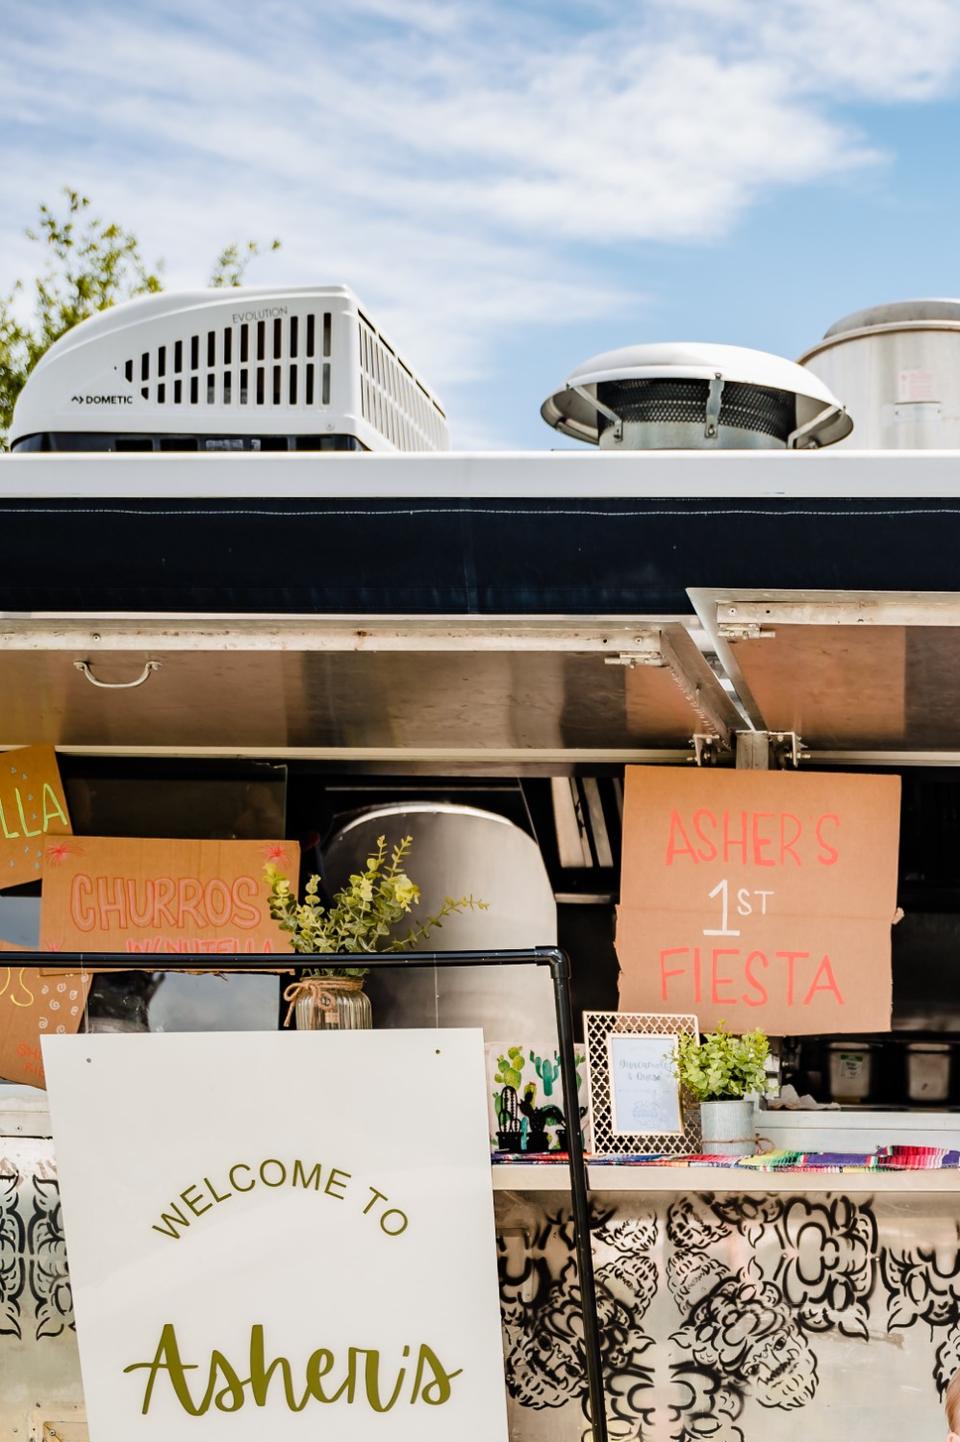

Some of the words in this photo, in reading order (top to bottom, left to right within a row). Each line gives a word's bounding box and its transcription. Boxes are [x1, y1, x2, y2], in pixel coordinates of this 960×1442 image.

[232, 306, 287, 322] EVOLUTION
[85, 395, 133, 404] DOMETIC
[0, 783, 68, 838] LLA
[664, 808, 841, 867] ASHER'S
[70, 873, 262, 933] CHURROS
[703, 879, 775, 937] 1ST
[659, 947, 845, 1007] FIESTA
[152, 1159, 352, 1240] WELCOME
[362, 1186, 408, 1236] TO
[123, 1323, 463, 1416] Asher's
